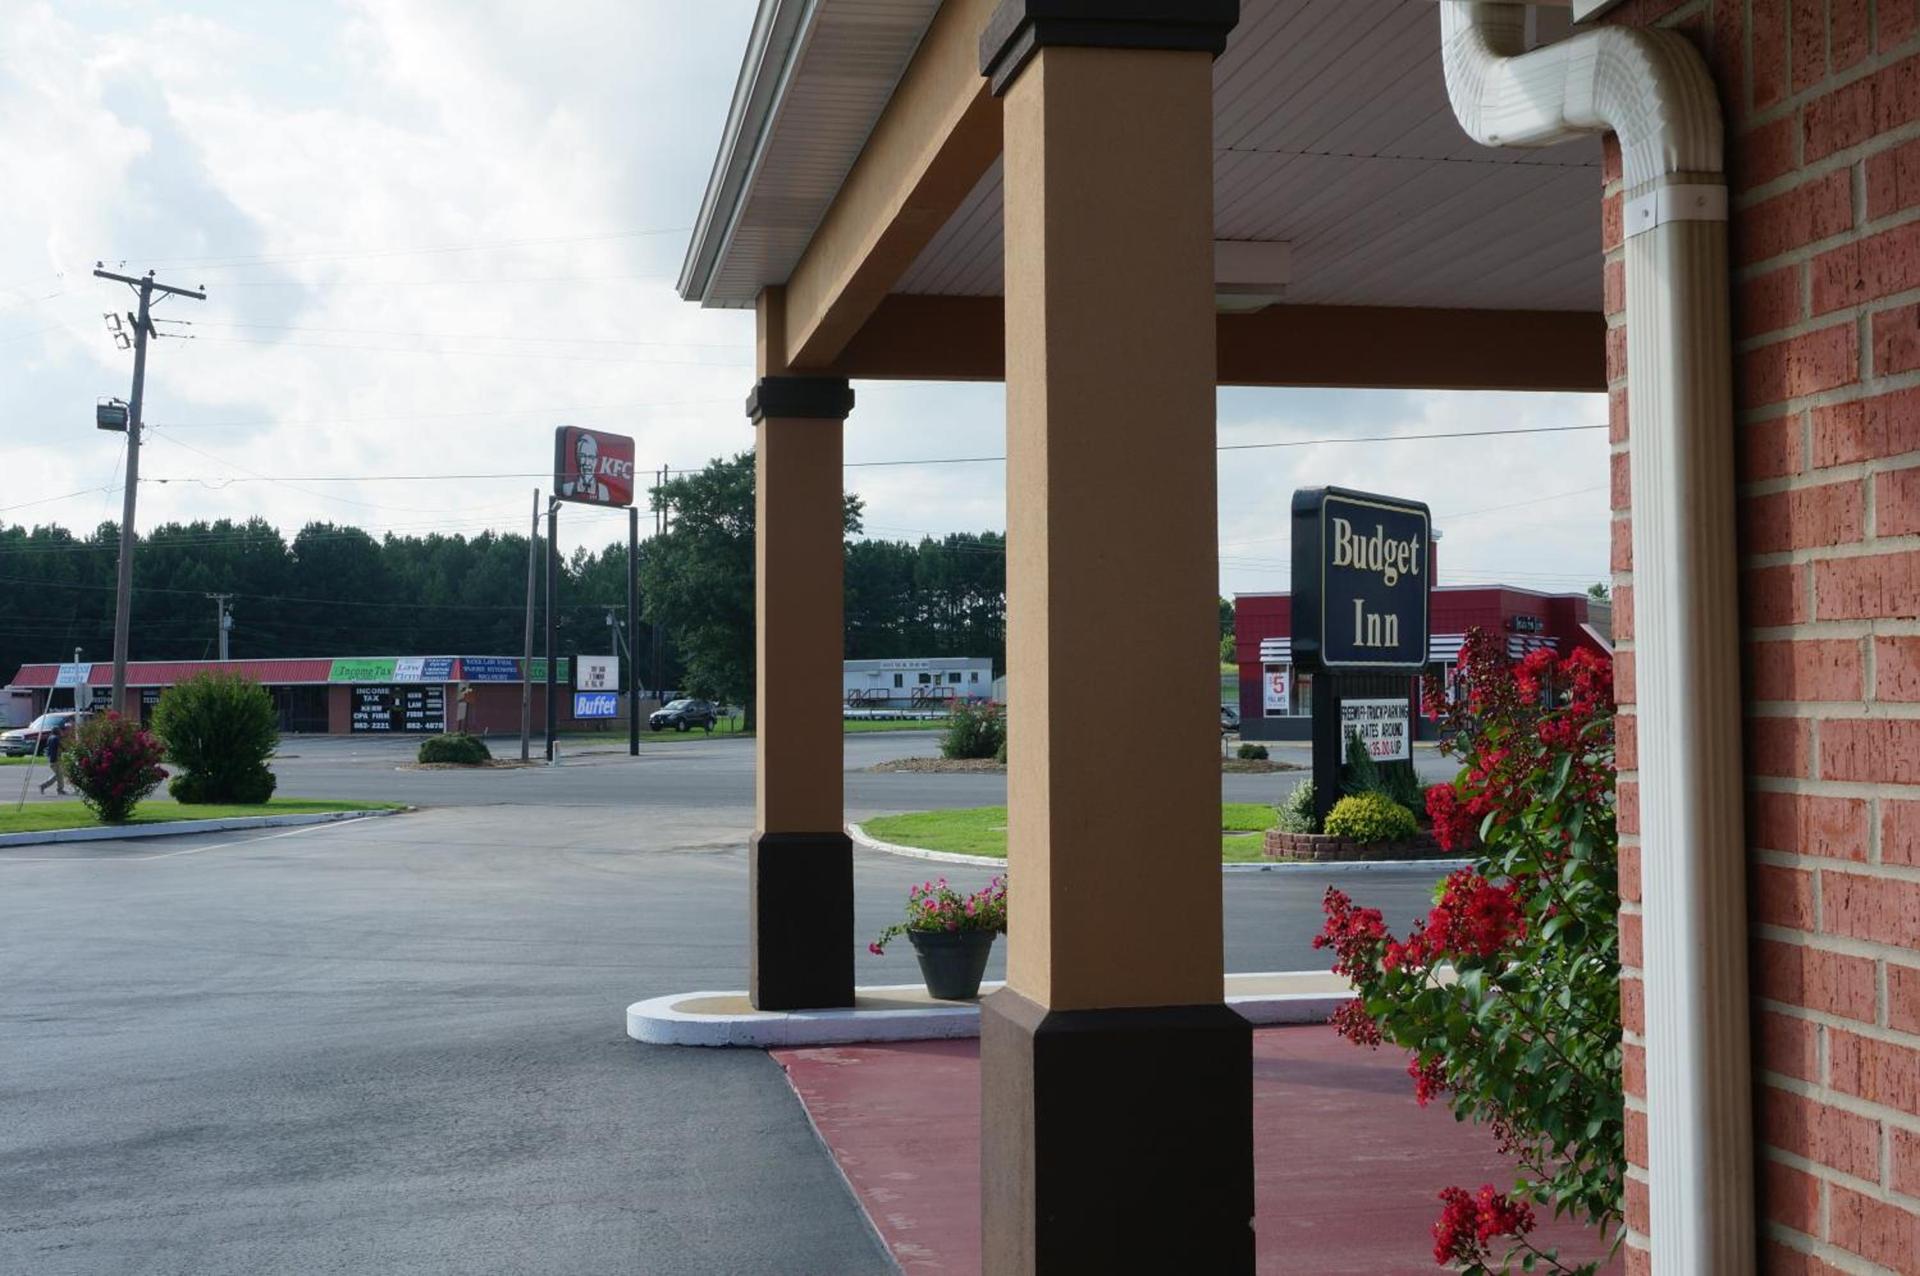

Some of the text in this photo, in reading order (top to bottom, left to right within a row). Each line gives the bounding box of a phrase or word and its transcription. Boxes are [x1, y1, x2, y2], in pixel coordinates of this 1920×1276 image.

[600, 456, 633, 480] KFC
[1332, 517, 1420, 588] Budget
[1352, 598, 1400, 648] Inn
[576, 695, 618, 716] Buffet
